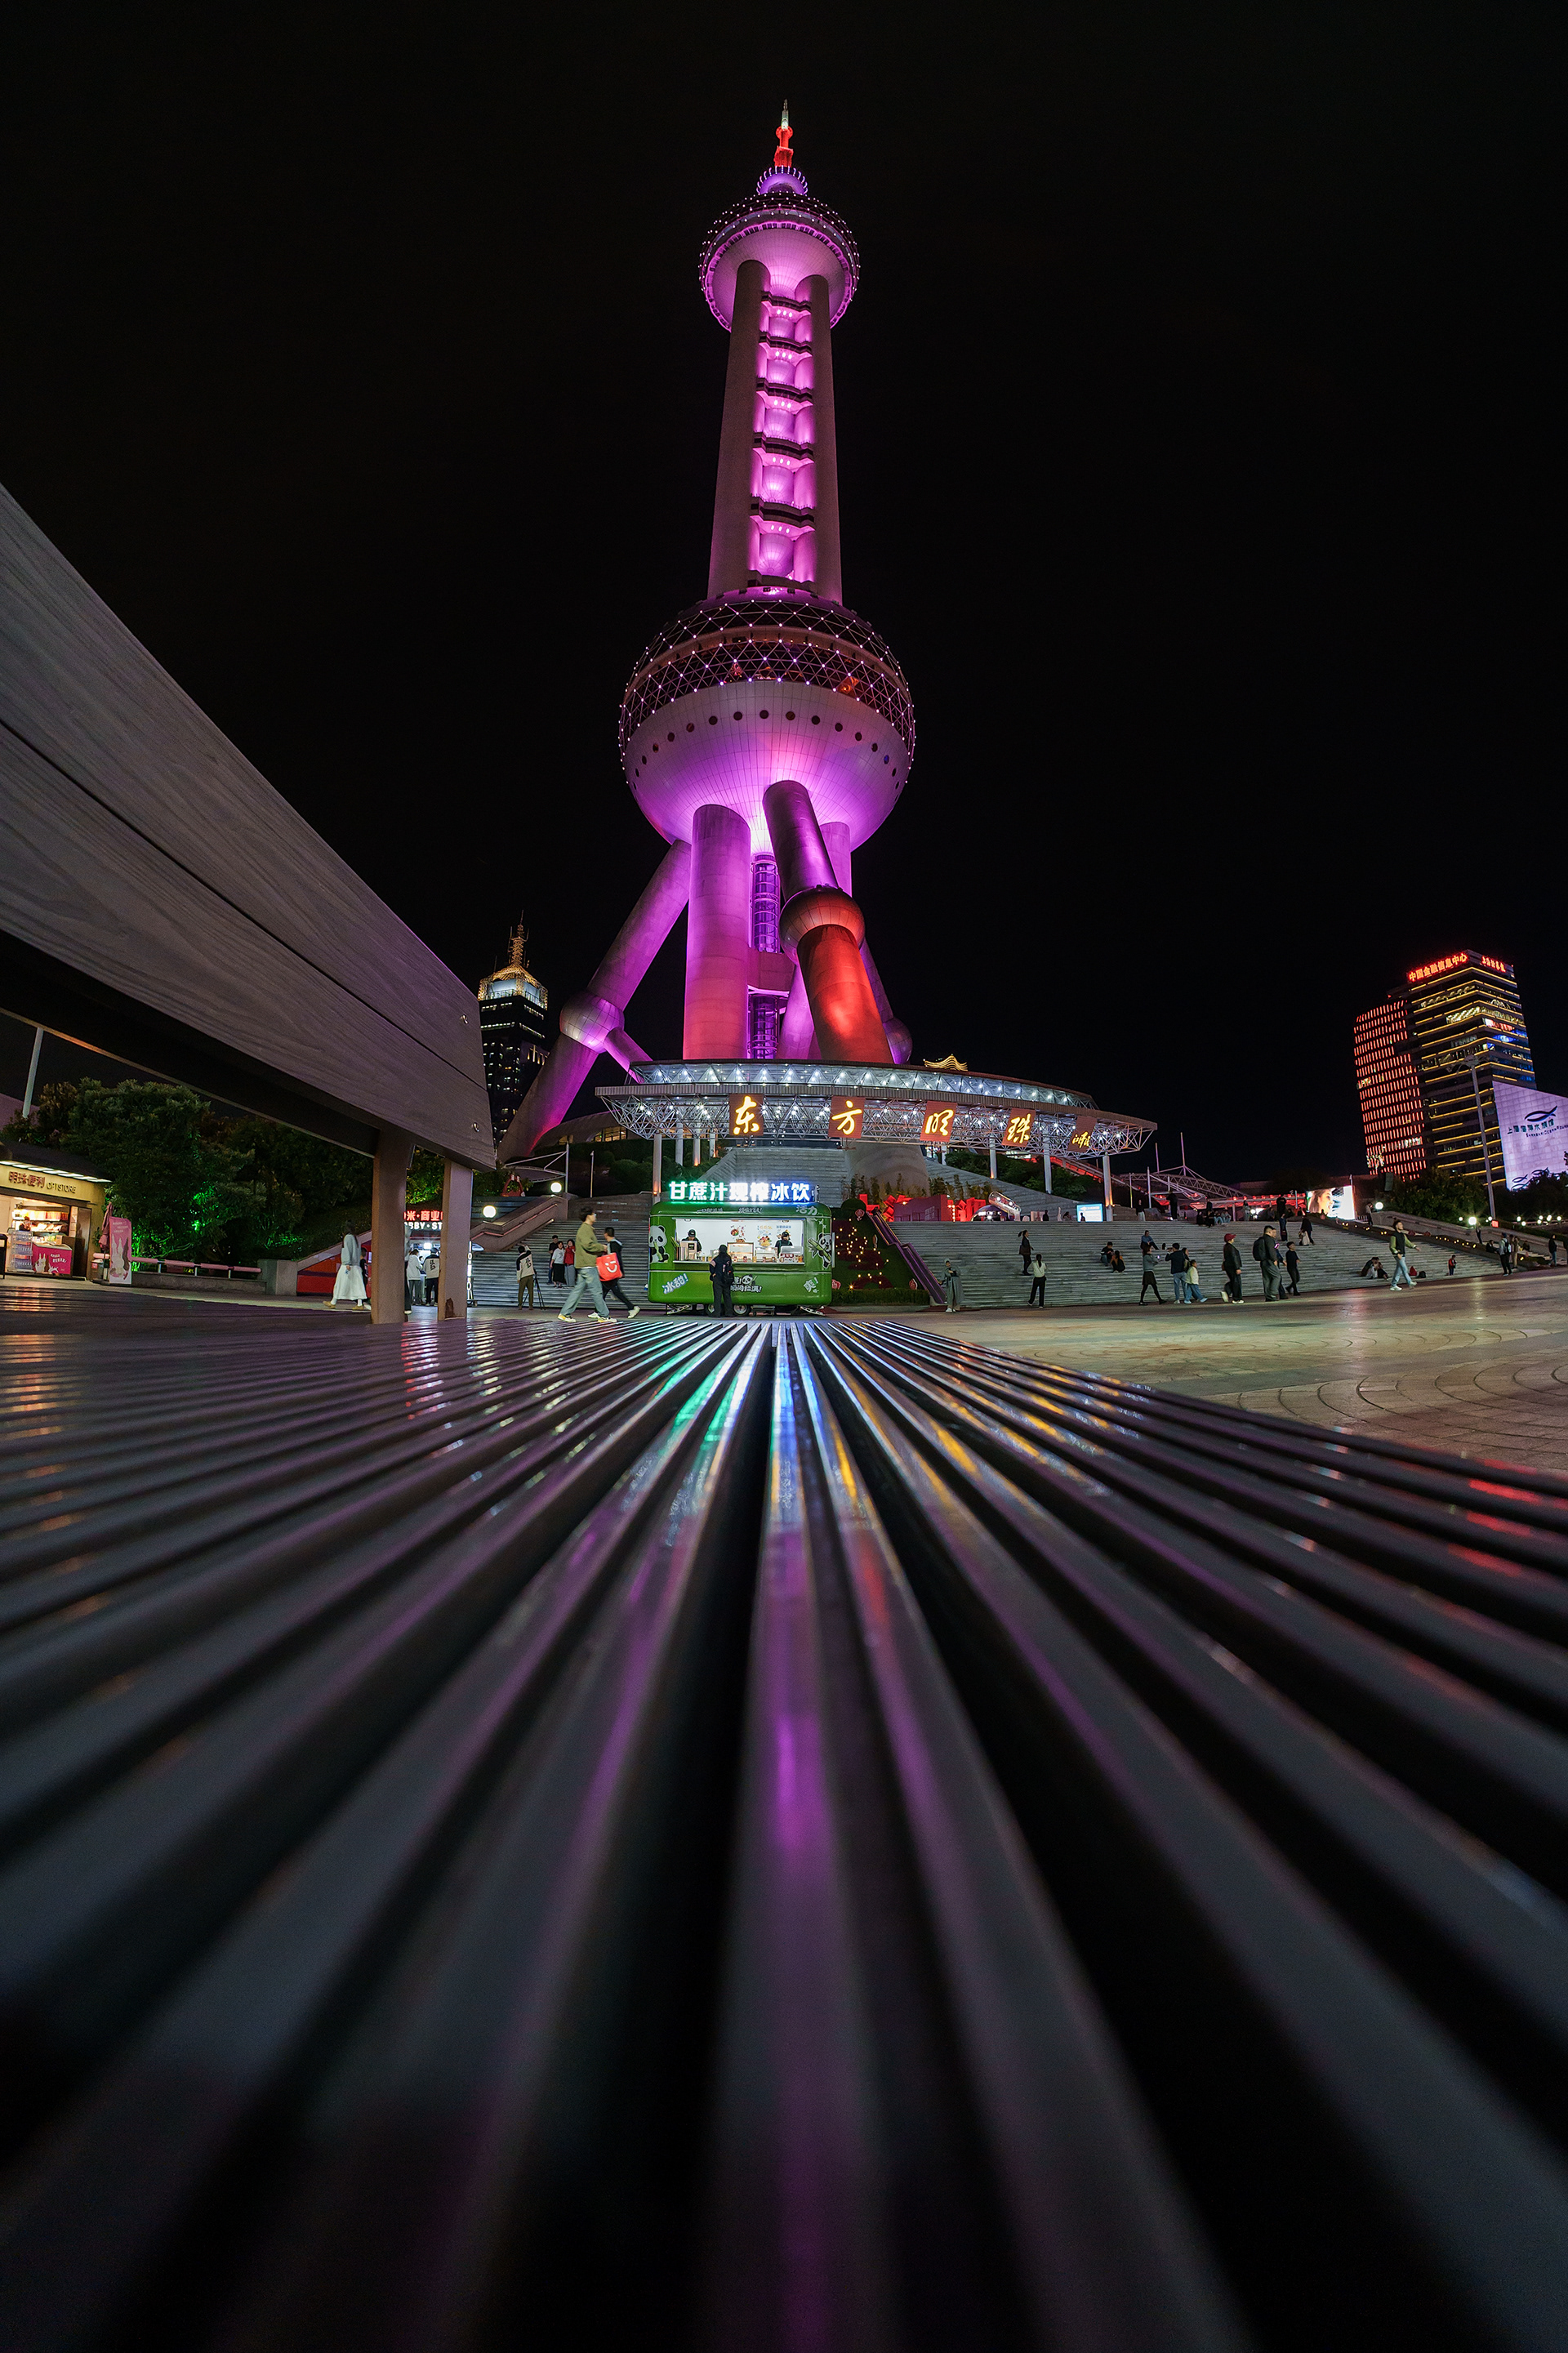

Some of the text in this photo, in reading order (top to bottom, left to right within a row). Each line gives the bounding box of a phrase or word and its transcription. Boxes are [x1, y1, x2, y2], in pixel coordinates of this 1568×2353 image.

[1409, 952, 1468, 982] 中国金融信息中心
[733, 1095, 1031, 1144] 东方明珠
[9, 1171, 46, 1188] 明珠便利
[669, 1181, 811, 1201] 甘蔗汁现榨冰饮
